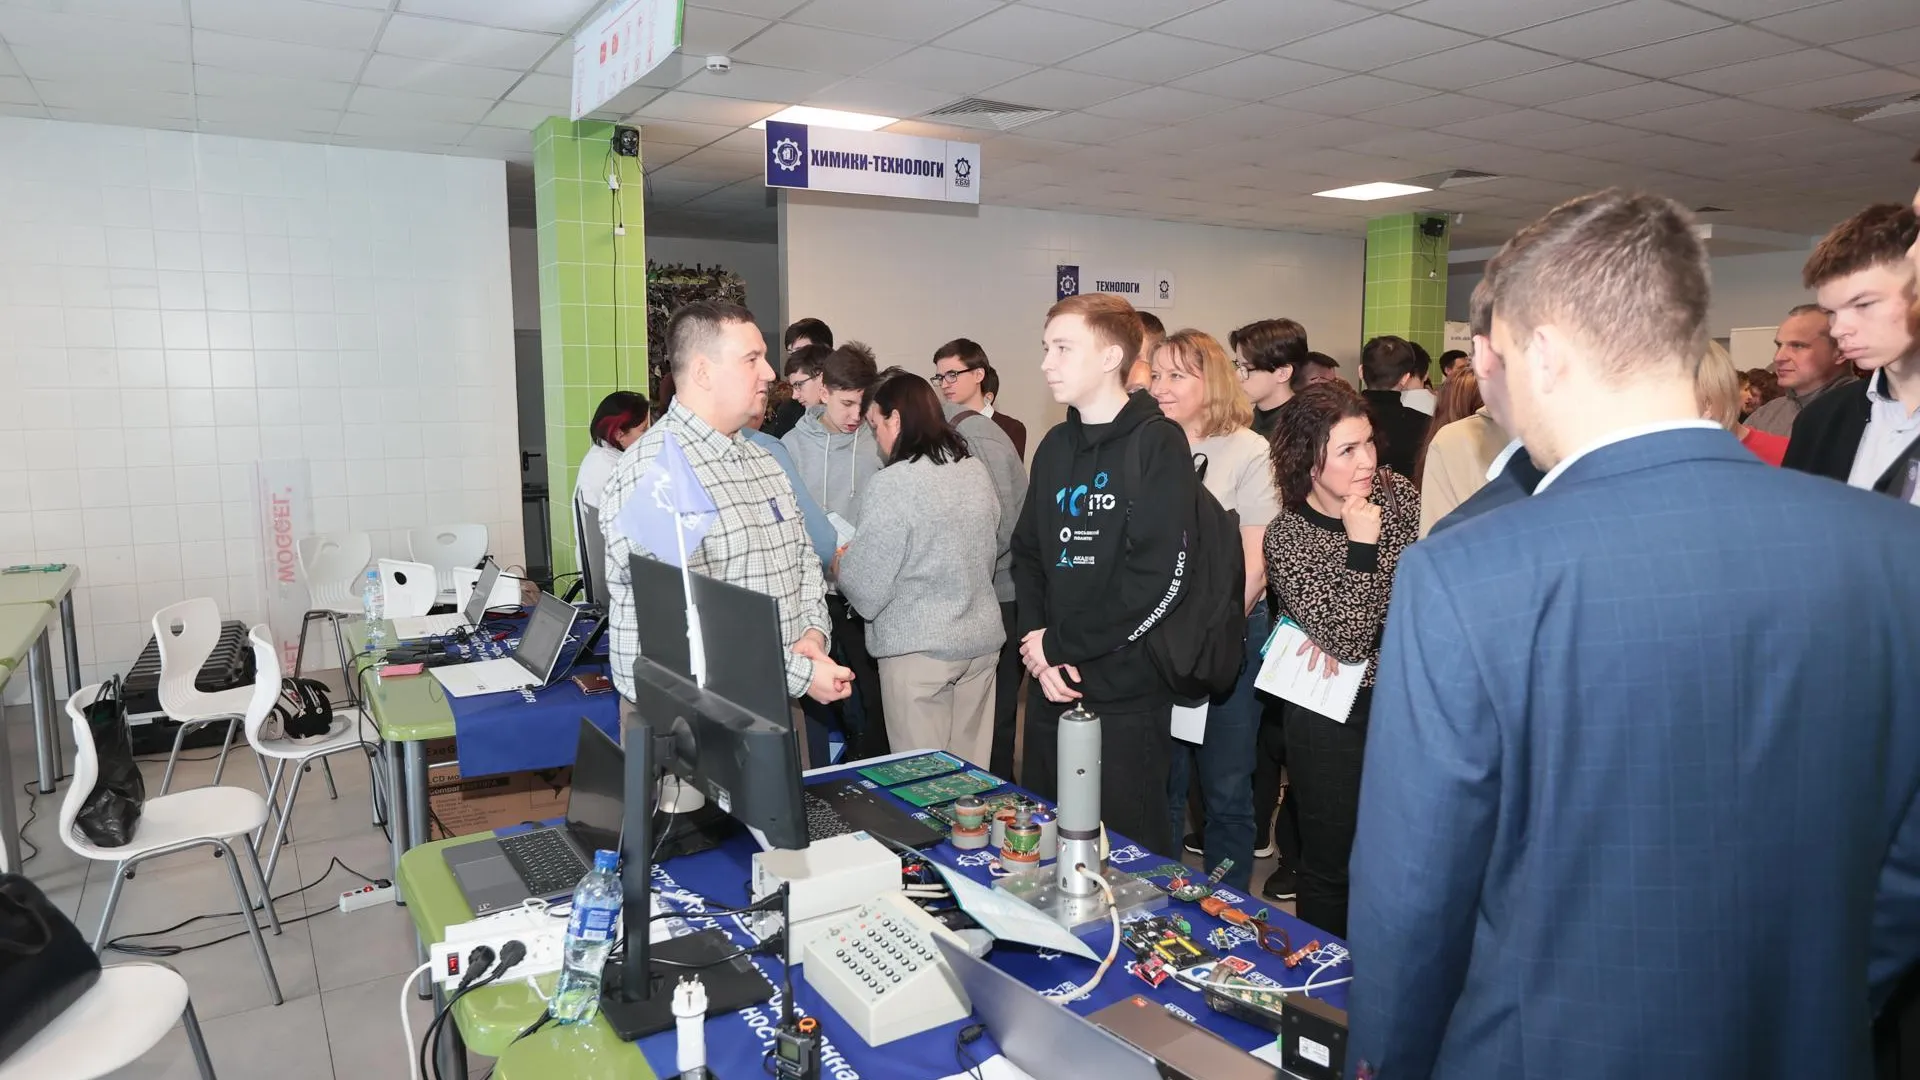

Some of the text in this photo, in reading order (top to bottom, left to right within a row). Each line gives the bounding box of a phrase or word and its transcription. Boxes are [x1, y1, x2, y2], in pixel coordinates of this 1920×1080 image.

[811, 149, 944, 178] ХИМИКИ-ТЕХНОЛОГИ
[1096, 281, 1140, 293] ТЕХНОЛОГИ
[1127, 551, 1187, 641] ВСЕВИДЯЩЕЕ ОКО
